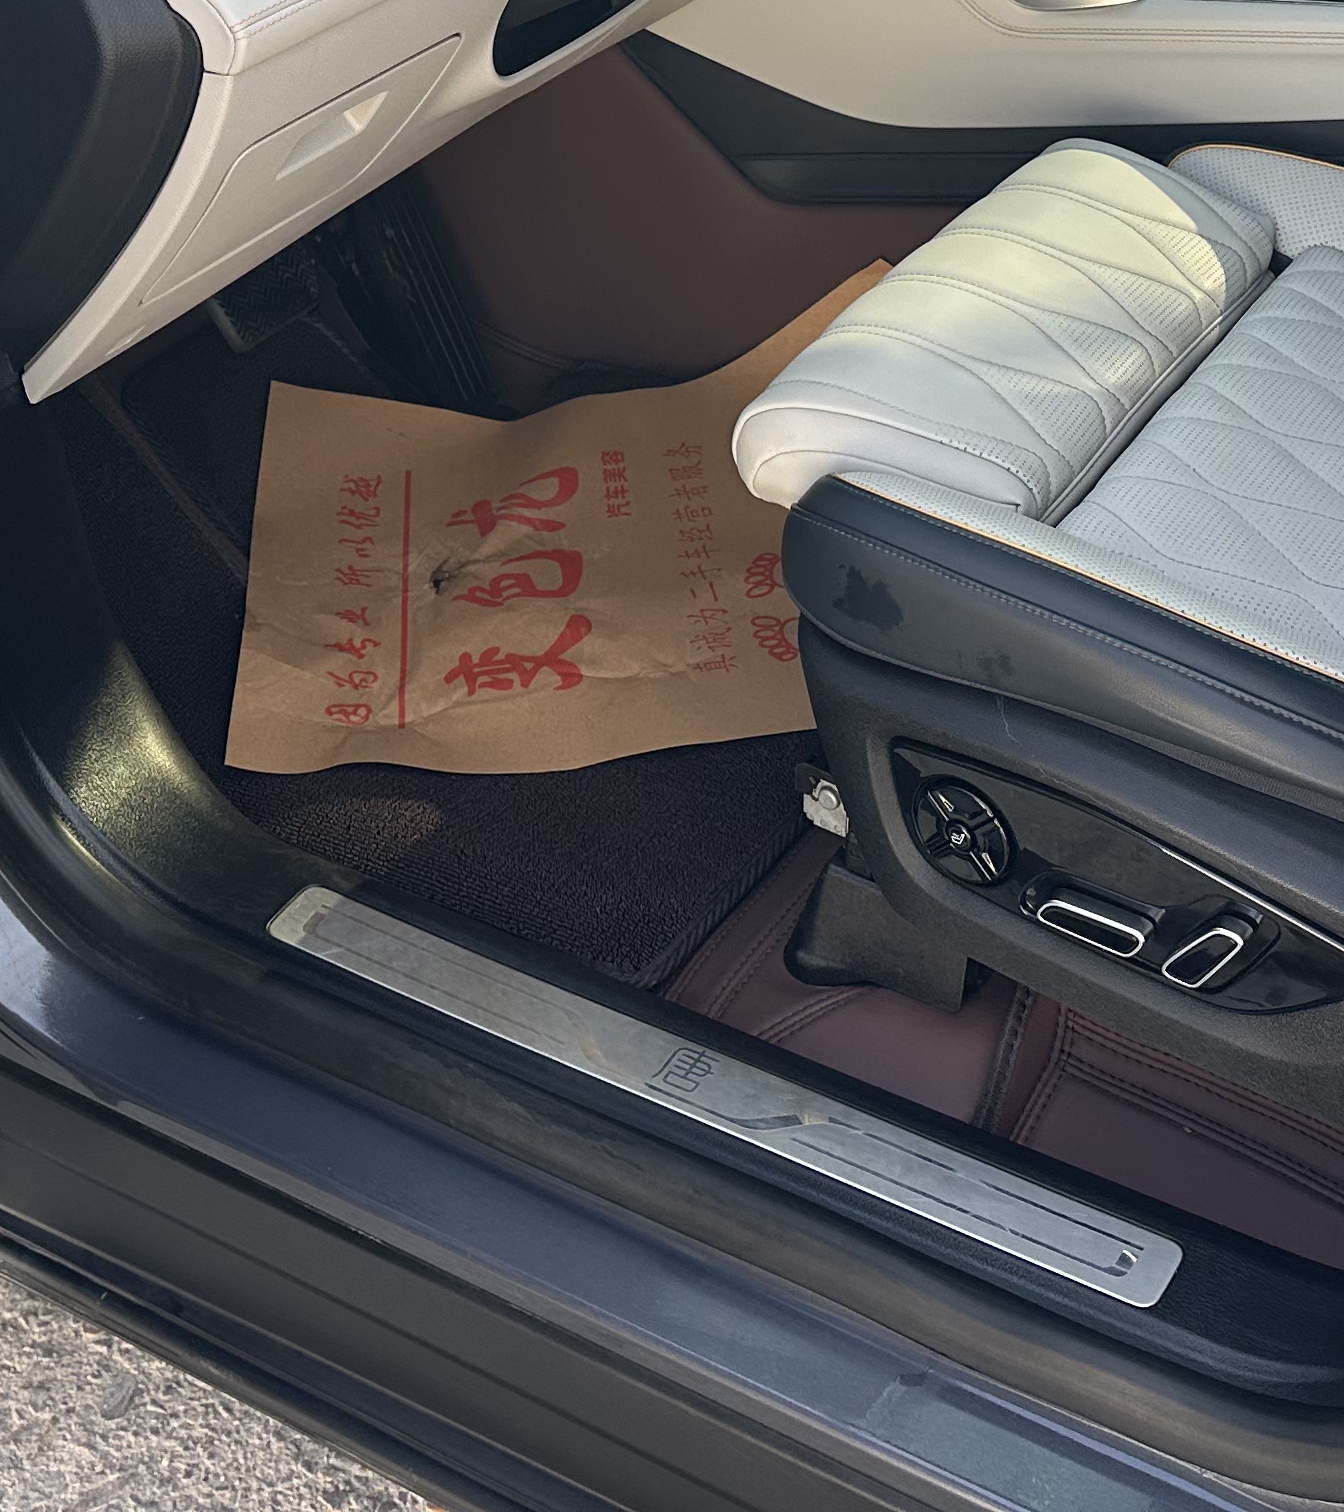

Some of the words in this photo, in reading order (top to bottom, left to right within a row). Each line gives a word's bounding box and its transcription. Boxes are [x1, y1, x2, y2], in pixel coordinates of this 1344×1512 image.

[442, 465, 593, 698] 变色龙
[599, 449, 629, 520] 汽车美容
[661, 441, 737, 675] 真诚为二手车经营者服务
